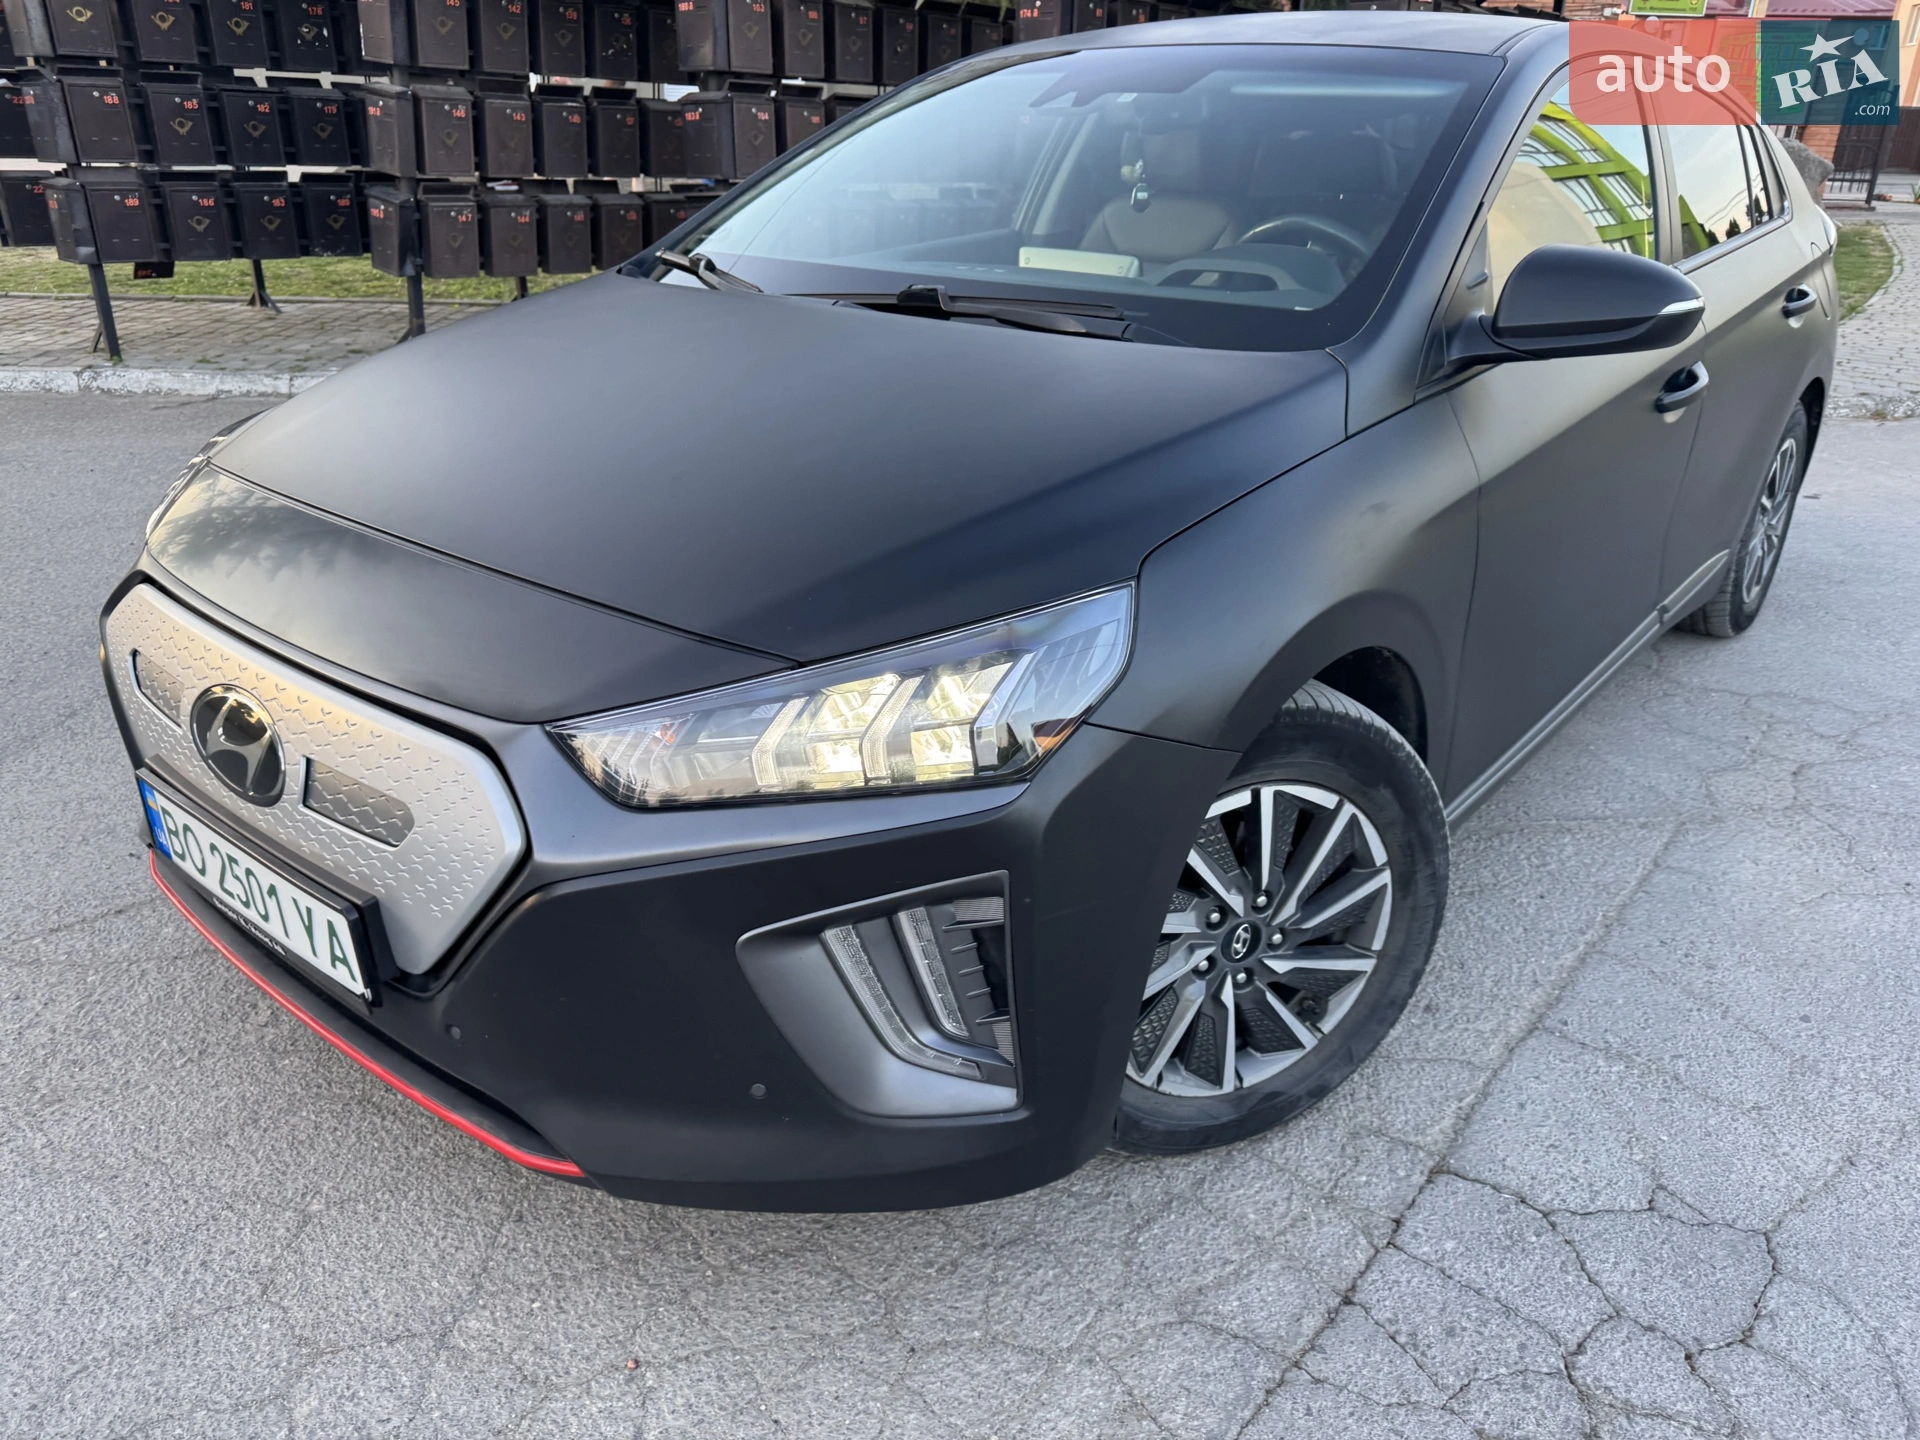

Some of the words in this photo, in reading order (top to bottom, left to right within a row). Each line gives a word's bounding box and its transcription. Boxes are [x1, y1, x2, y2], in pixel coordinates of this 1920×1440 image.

[241, 1, 254, 10] 181
[508, 4, 521, 14] 142
[104, 95, 119, 104] 188
[183, 101, 199, 109] 185
[257, 104, 270, 113] 182
[452, 109, 466, 118] 146
[513, 112, 526, 121] 143
[125, 198, 139, 207] 189
[199, 198, 214, 207] 186
[457, 213, 472, 224] 147
[517, 215, 530, 223] 144
[154, 826, 168, 847] UA
[160, 804, 206, 877] BO
[210, 842, 290, 939] 2501
[291, 896, 357, 983] YA
